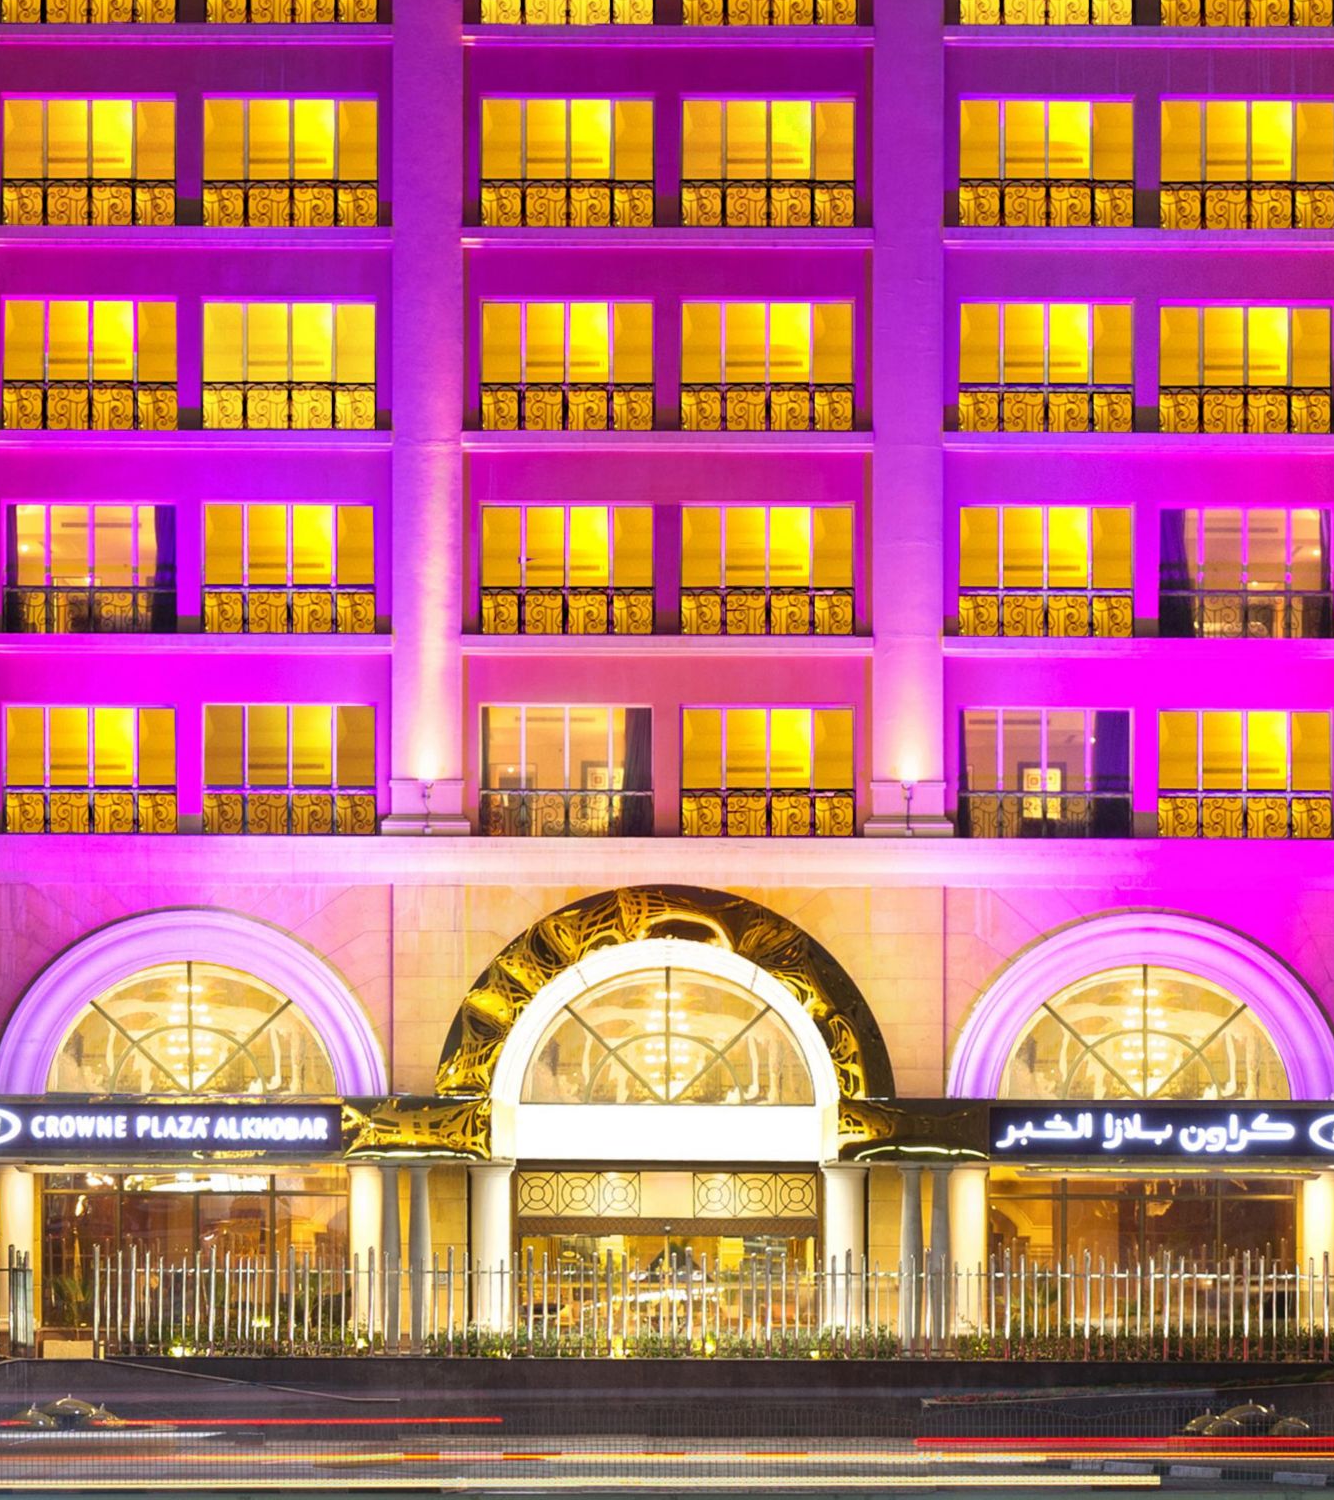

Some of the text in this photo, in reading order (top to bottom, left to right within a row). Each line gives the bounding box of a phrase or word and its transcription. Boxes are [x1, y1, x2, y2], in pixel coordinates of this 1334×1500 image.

[30, 1115, 329, 1141] CROWNE PLAZA ALKHOBAR
[995, 1112, 1296, 1153] كراون بلازا الخبر
